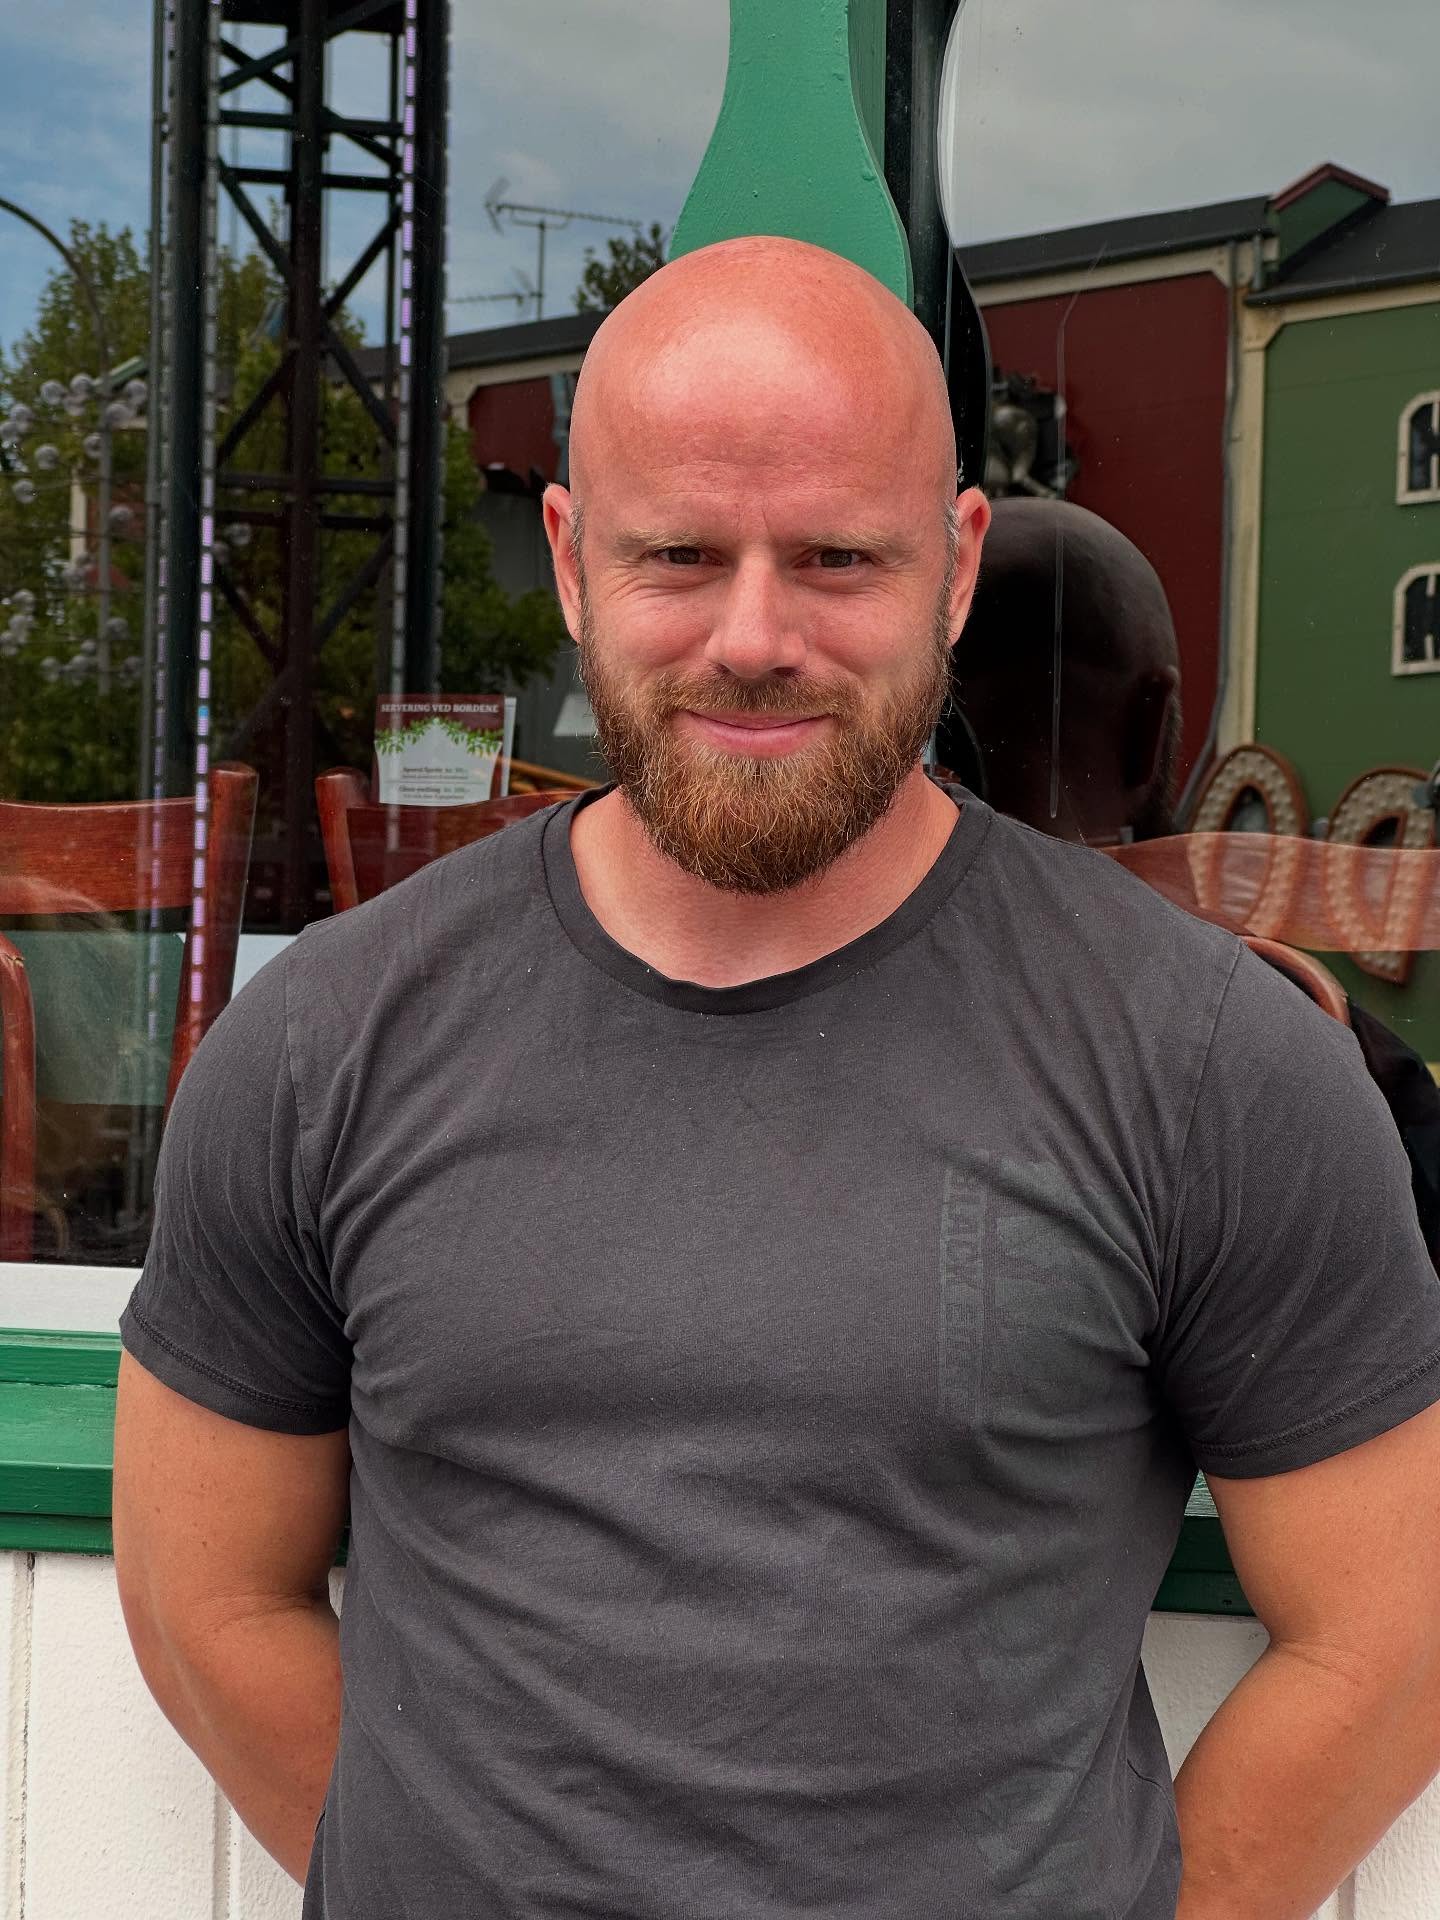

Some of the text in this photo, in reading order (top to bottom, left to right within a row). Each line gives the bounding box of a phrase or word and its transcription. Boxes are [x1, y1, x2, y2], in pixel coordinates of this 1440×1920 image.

[381, 703, 499, 713] SERVERING VED BORDENE
